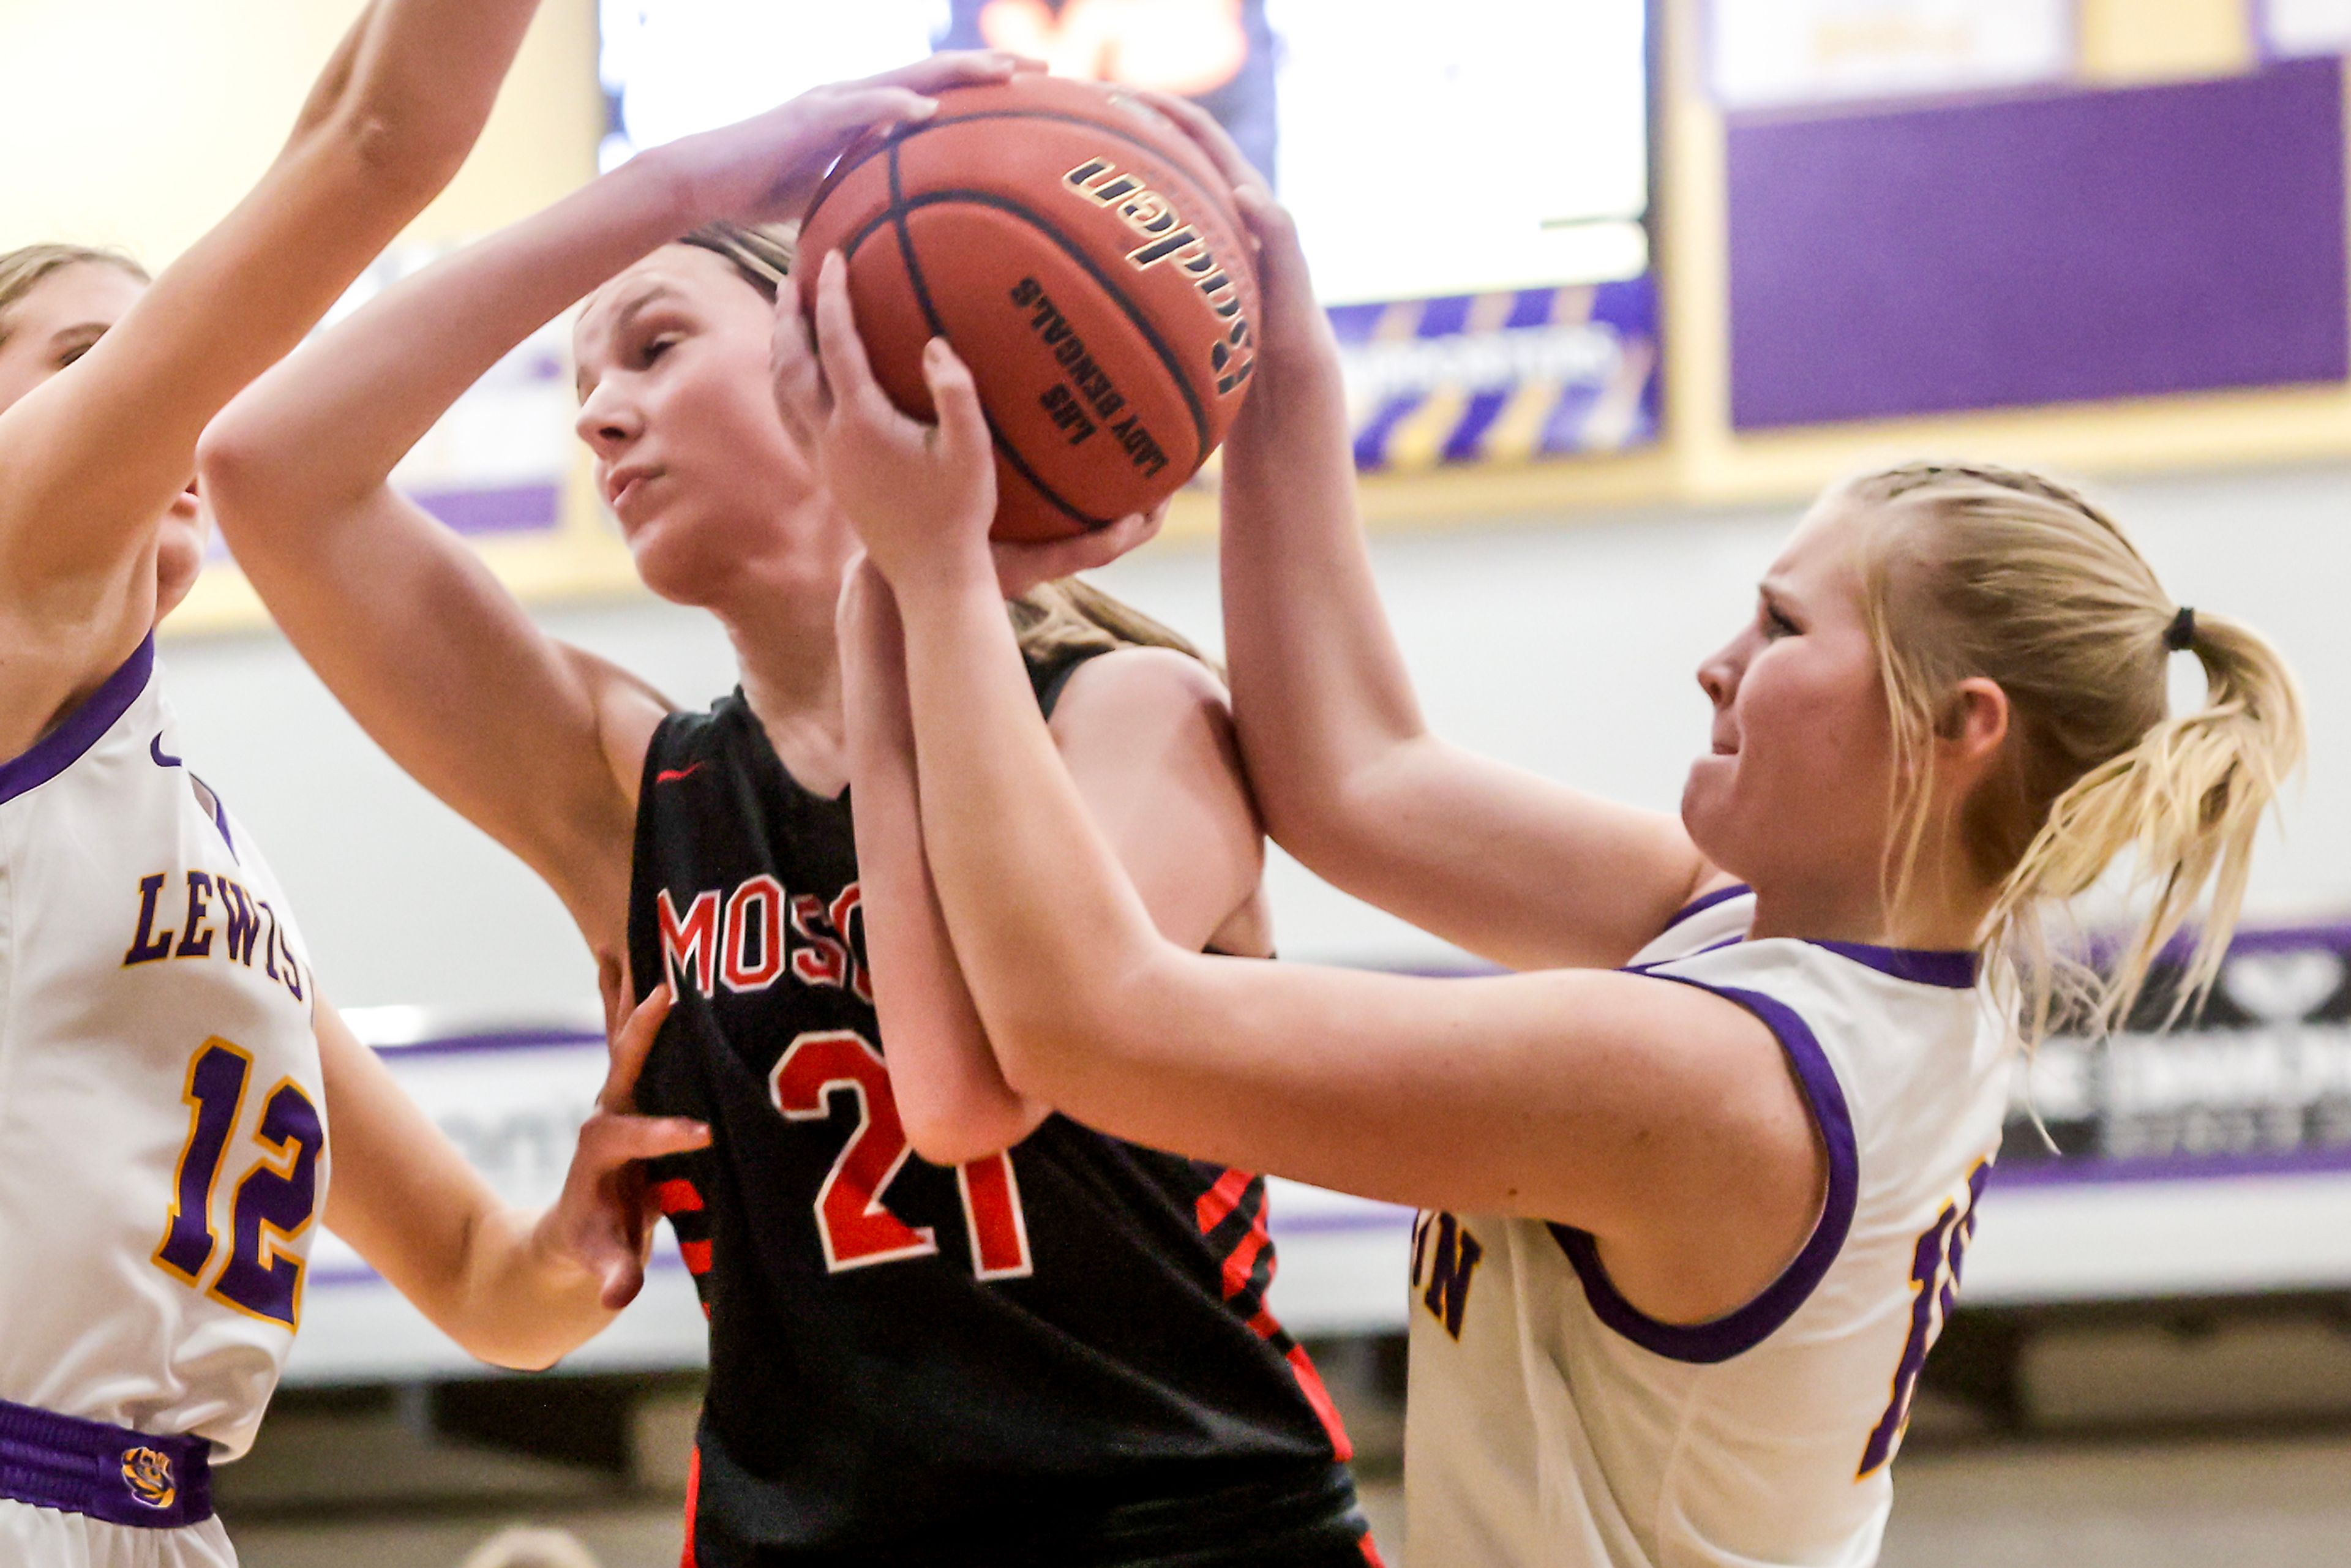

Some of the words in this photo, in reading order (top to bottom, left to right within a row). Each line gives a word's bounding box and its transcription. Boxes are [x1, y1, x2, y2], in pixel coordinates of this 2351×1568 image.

[1011, 277, 1126, 420] BENGALS
[1062, 156, 1253, 397] Baden
[1111, 413, 1170, 479] LADY
[121, 868, 314, 1026] LEWIS
[150, 1035, 324, 1336] 12
[768, 1029, 1033, 1281] 21
